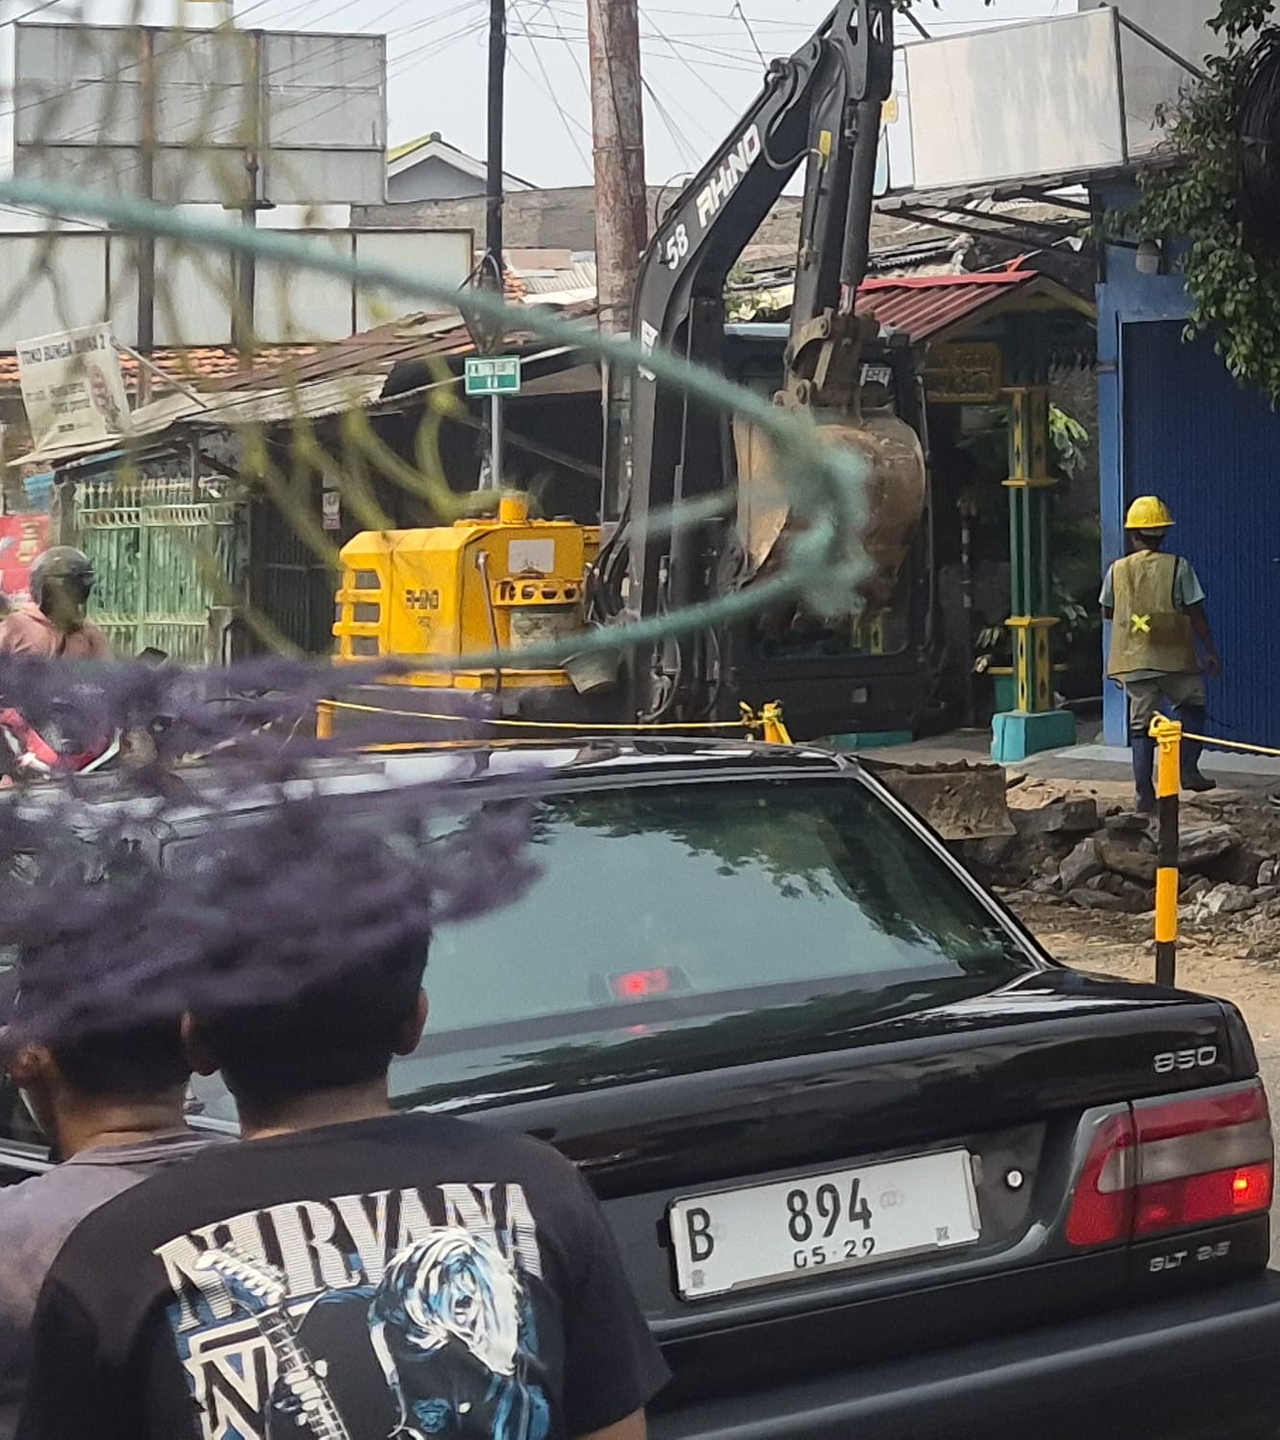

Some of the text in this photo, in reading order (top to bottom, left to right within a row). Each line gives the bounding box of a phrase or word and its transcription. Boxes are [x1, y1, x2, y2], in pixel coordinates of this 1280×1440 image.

[1153, 1046, 1217, 1073] 850
[686, 1177, 872, 1262] B 894
[152, 1182, 543, 1332] NIRVANA
[1149, 1250, 1187, 1272] GLT
